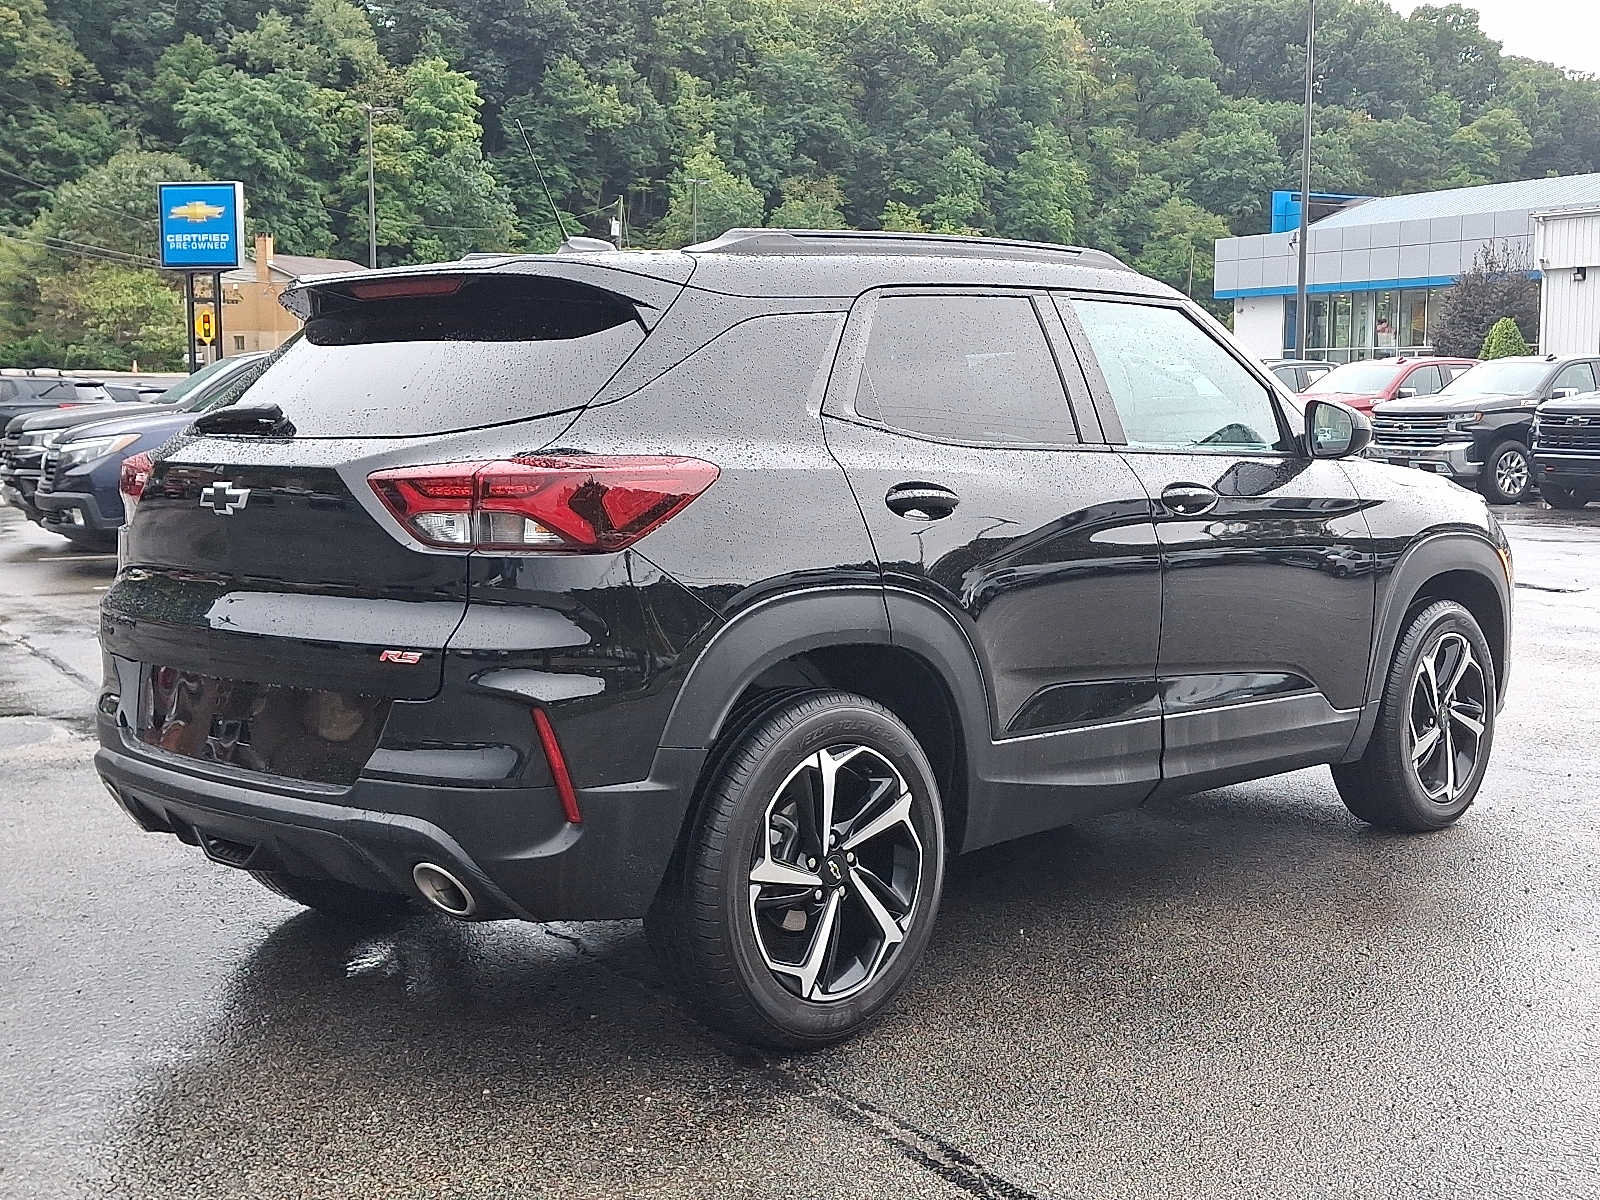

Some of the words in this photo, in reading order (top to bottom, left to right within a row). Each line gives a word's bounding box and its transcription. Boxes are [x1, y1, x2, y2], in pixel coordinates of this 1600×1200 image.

[166, 233, 230, 242] CERTIFIED
[169, 241, 227, 250] PRE-OWNED
[379, 649, 423, 664] RS
